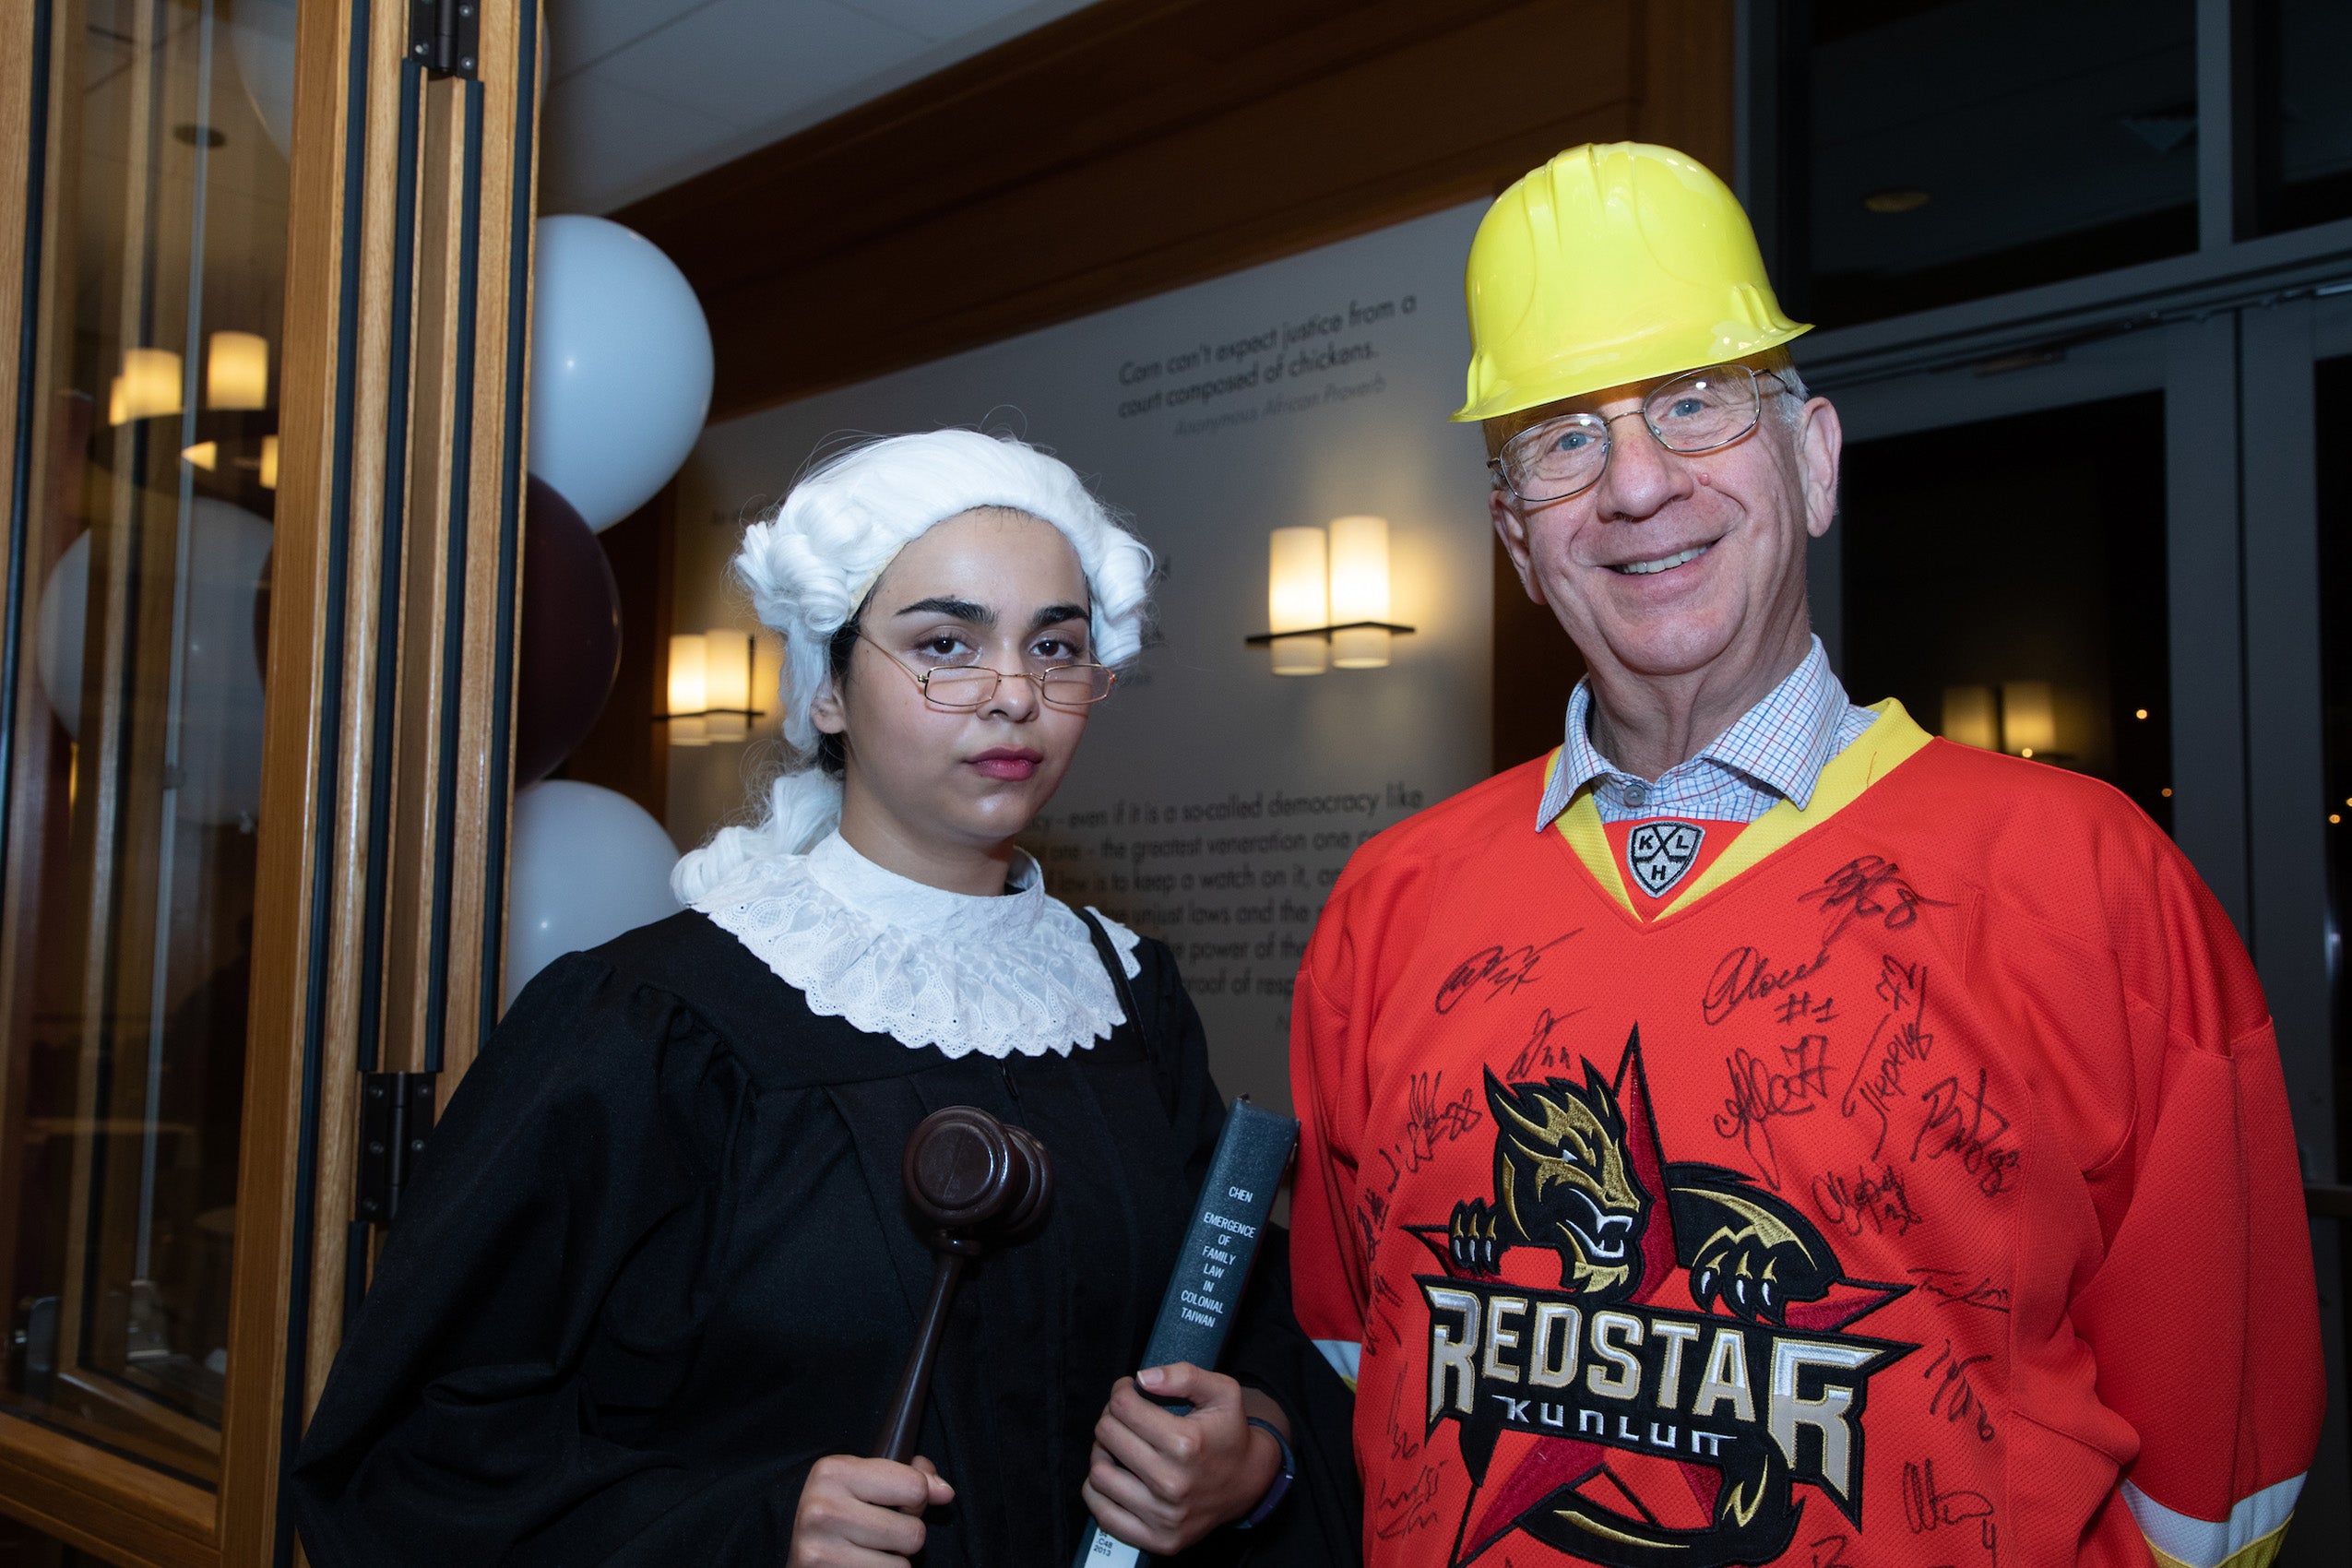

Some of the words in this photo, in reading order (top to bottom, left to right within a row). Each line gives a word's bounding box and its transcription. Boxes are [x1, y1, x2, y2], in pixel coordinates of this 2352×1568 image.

[1215, 327, 1277, 363] expect
[1280, 312, 1344, 350] justice
[1348, 297, 1396, 327] from
[1400, 294, 1418, 315] a
[1118, 390, 1163, 420] court
[1165, 360, 1259, 407] composed
[1263, 352, 1286, 385] of
[1068, 810, 1107, 829] even
[1164, 805, 1178, 824] a
[1181, 791, 1263, 822] so-called
[1268, 790, 1380, 819] democracy
[1385, 781, 1424, 810] like
[1099, 835, 1128, 860] the
[1130, 836, 1202, 865] greatest
[1206, 828, 1307, 856] veneration
[1312, 830, 1351, 851] one
[1132, 863, 1177, 897] keep
[1181, 873, 1194, 891] a
[1199, 861, 1255, 890] watch
[1261, 867, 1287, 888] on
[1186, 898, 1229, 926] laws
[1234, 896, 1275, 923] and
[1277, 897, 1310, 923] the
[1188, 941, 1248, 967] power
[1252, 930, 1277, 959] of
[1229, 966, 1252, 997] of
[1229, 1186, 1253, 1204] CHEN
[1204, 1212, 1256, 1239] EMERGENCE
[1218, 1234, 1232, 1246] OF
[1202, 1246, 1237, 1265] FAMILY
[1203, 1264, 1225, 1279] LAW
[1203, 1280, 1215, 1293] IN
[1181, 1289, 1224, 1314] COLONIAL
[1181, 1307, 1217, 1328] TAIWAN
